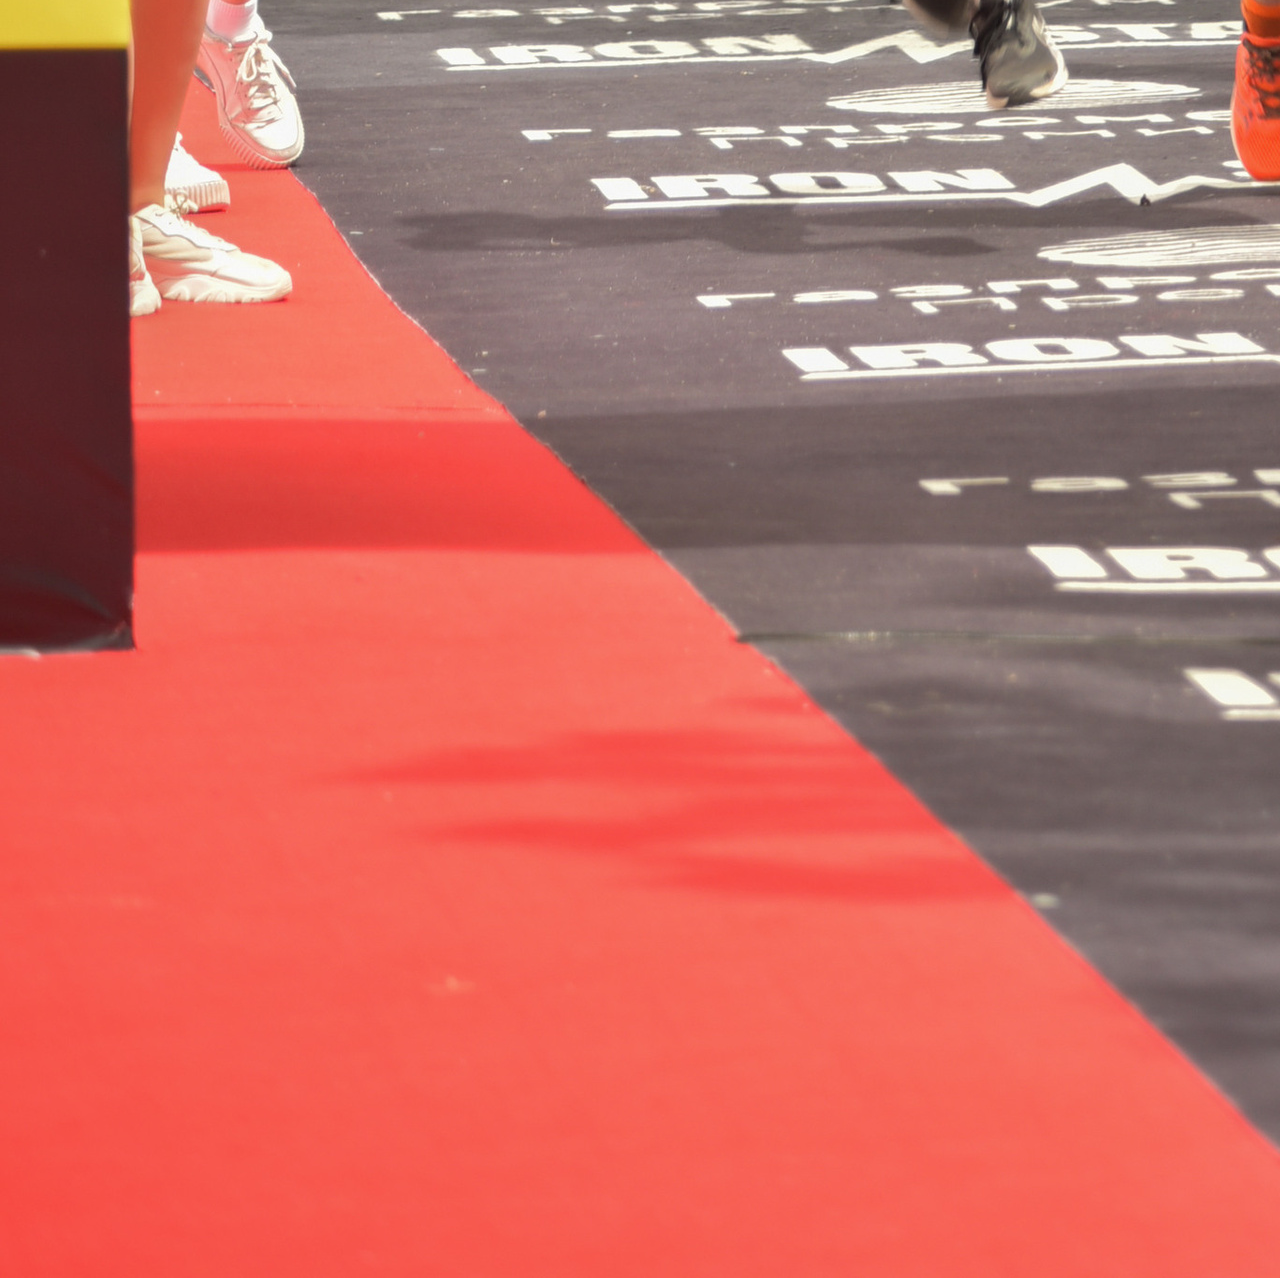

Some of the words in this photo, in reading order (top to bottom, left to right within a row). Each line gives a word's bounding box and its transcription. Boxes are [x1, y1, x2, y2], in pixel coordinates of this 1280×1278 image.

[436, 34, 813, 65] IRON
[590, 168, 1018, 201] IRON
[781, 331, 1267, 372] IRON
